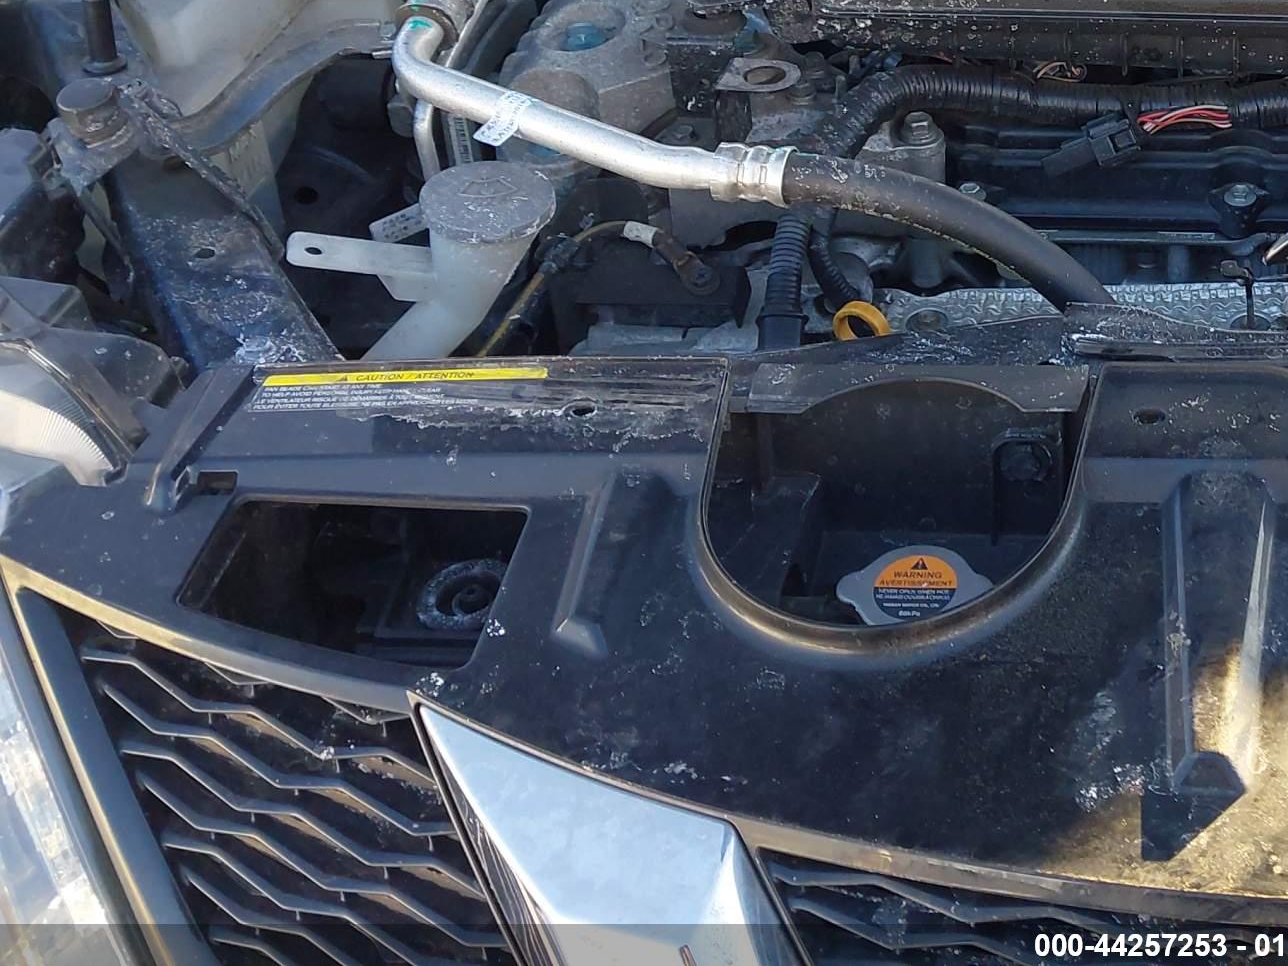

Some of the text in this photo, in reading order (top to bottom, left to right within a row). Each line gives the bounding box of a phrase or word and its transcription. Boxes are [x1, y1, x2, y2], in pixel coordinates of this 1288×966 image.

[356, 373, 404, 382] CAUTION
[415, 371, 475, 380] ATTENTION
[893, 570, 942, 579] WARNING
[879, 579, 953, 587] AVERTISSEMENT
